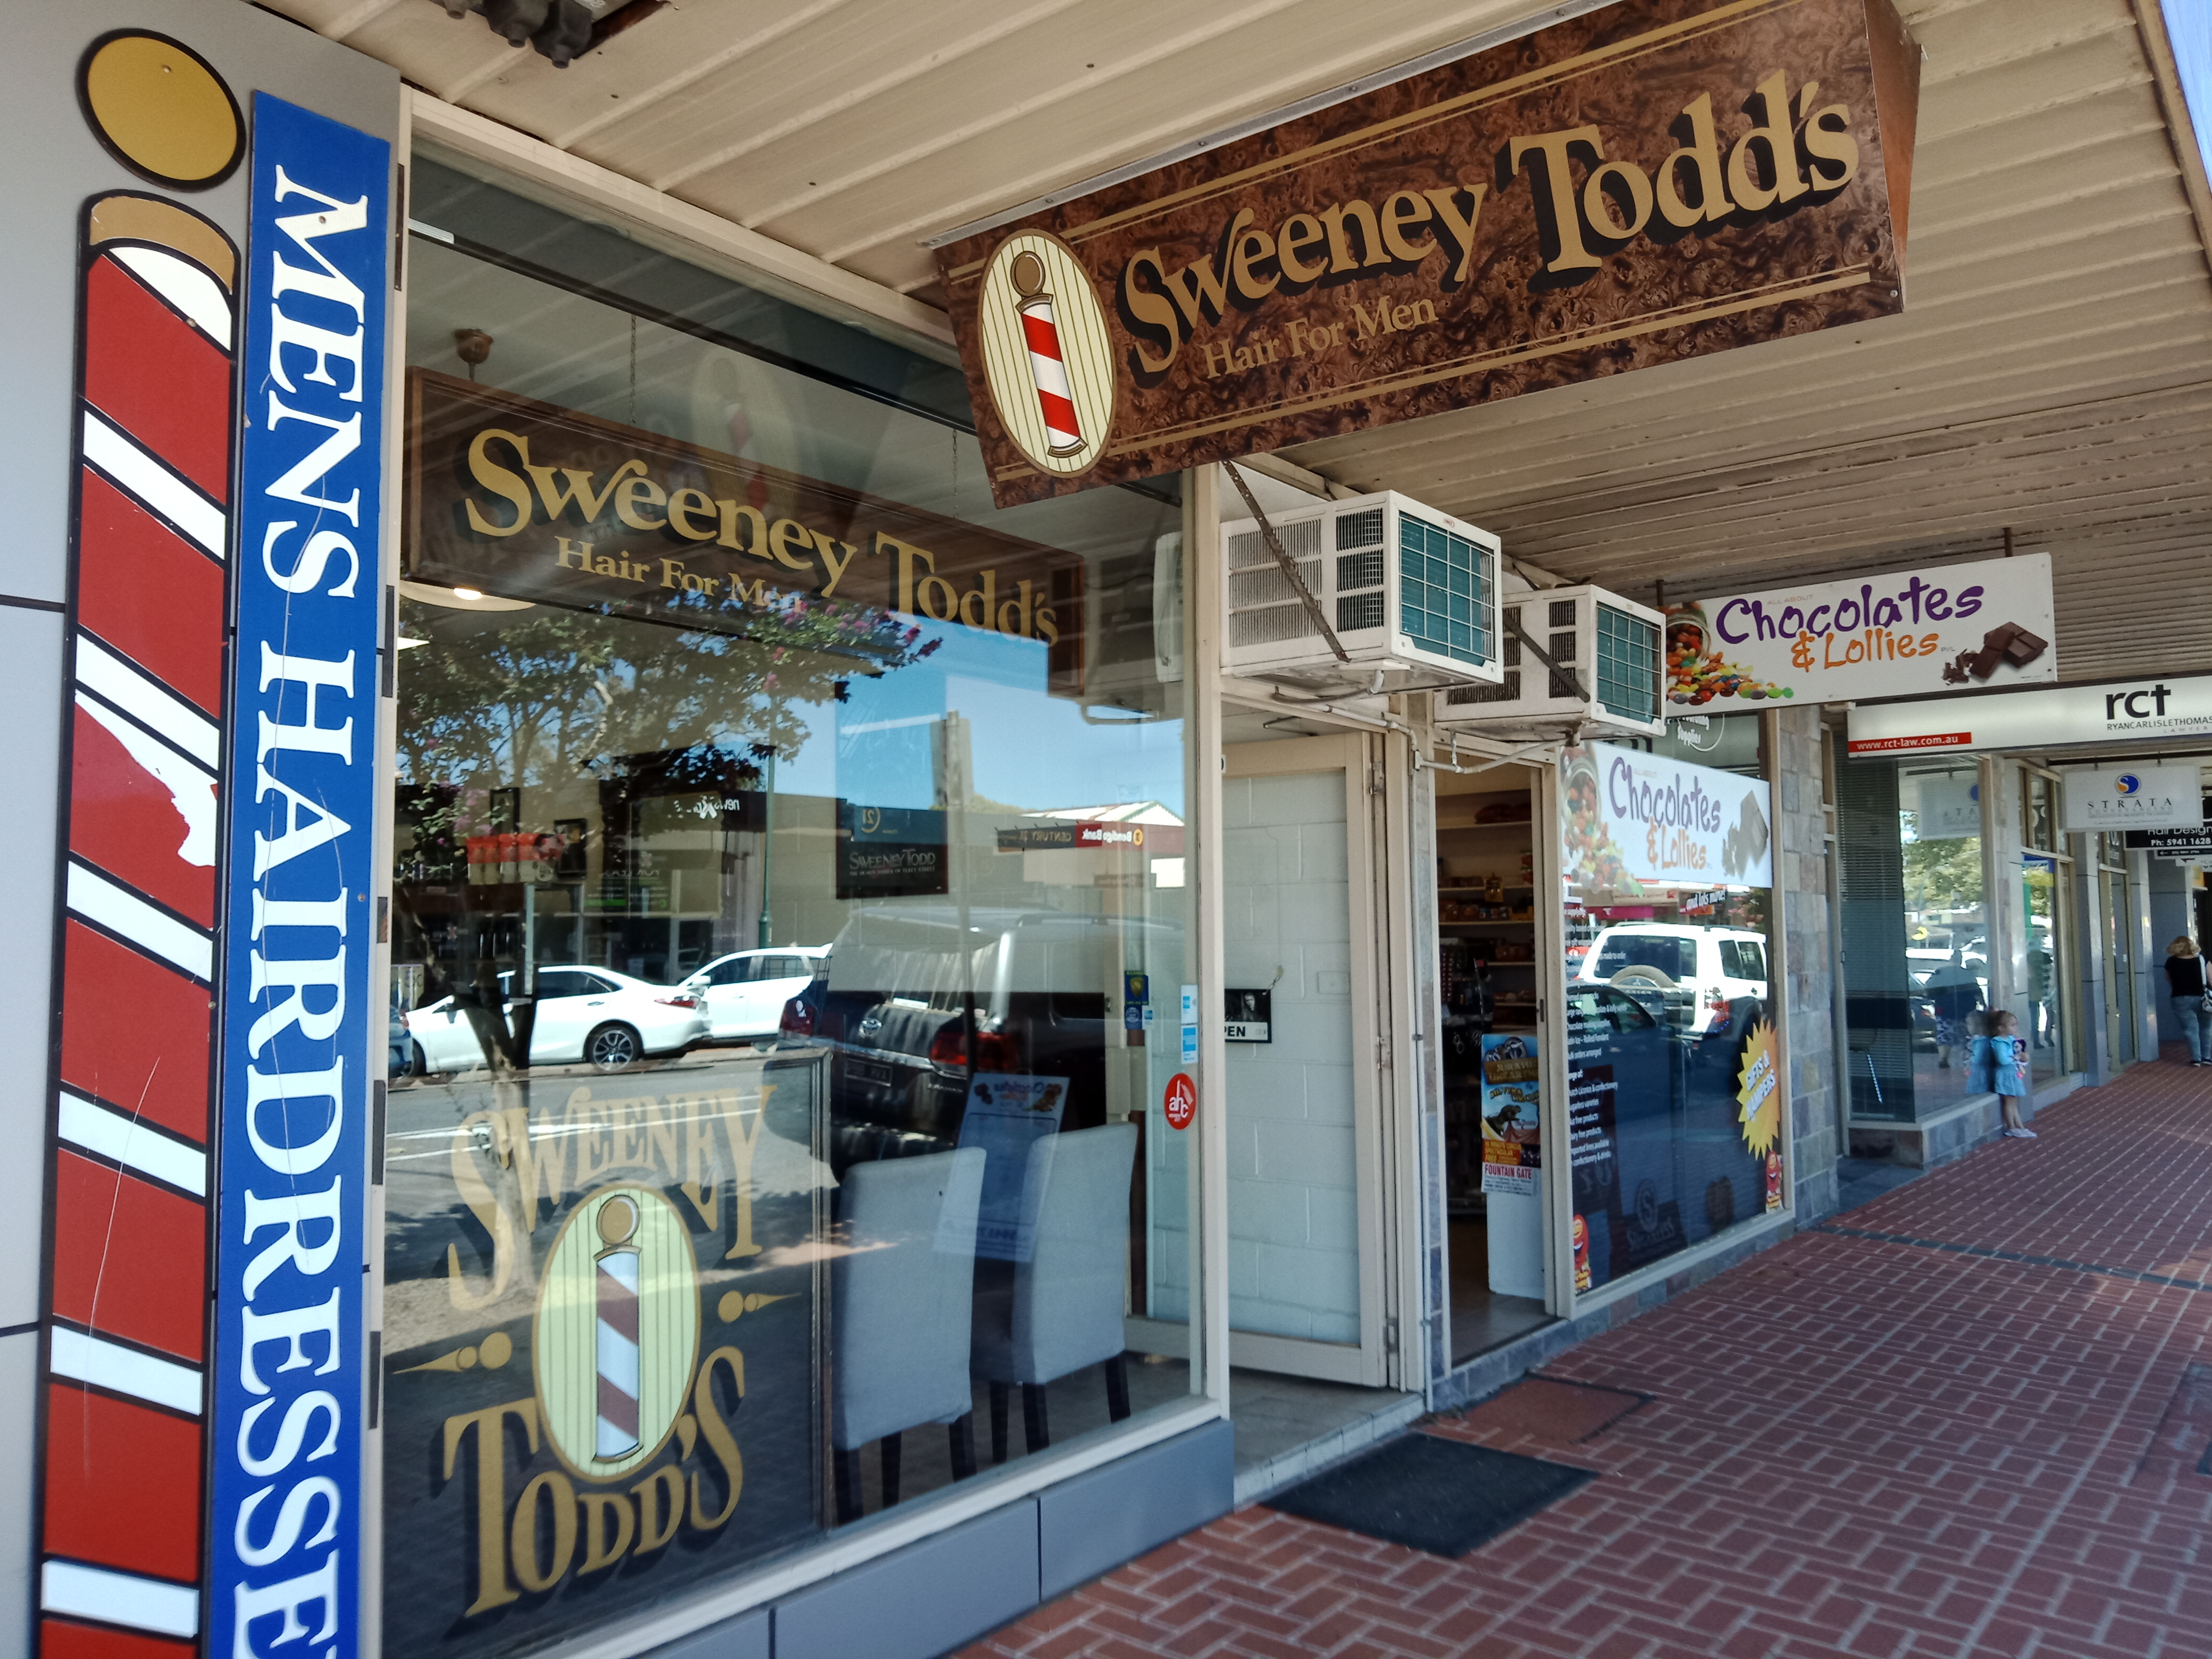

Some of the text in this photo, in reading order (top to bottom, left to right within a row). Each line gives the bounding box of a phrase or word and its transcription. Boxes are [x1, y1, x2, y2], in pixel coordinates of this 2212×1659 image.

[1126, 69, 1859, 373] Sweeney Todd's
[1202, 295, 1439, 379] Hair For Men
[465, 429, 1059, 648] Sweeney Todd's
[555, 536, 802, 614] Hair For Men
[1784, 594, 1813, 603] ABOUT
[1716, 576, 1984, 644] Chocolates
[1791, 631, 1815, 673] &
[1824, 628, 1940, 670] Lollies
[2106, 684, 2172, 720] rct
[1856, 736, 1959, 750] www.rct-law.com.au
[1608, 756, 1721, 833] Chocolates
[2088, 798, 2172, 809] STRATA
[849, 849, 936, 870] SWEENEY TODD
[1647, 816, 1707, 871] & Lollies
[233, 164, 368, 1659] MENS HAIRDRESSE
[447, 1084, 777, 1311] SWEENEY
[1485, 1163, 1532, 1179] FOUNTAIN GATE
[443, 1345, 745, 1618] TODD'S
